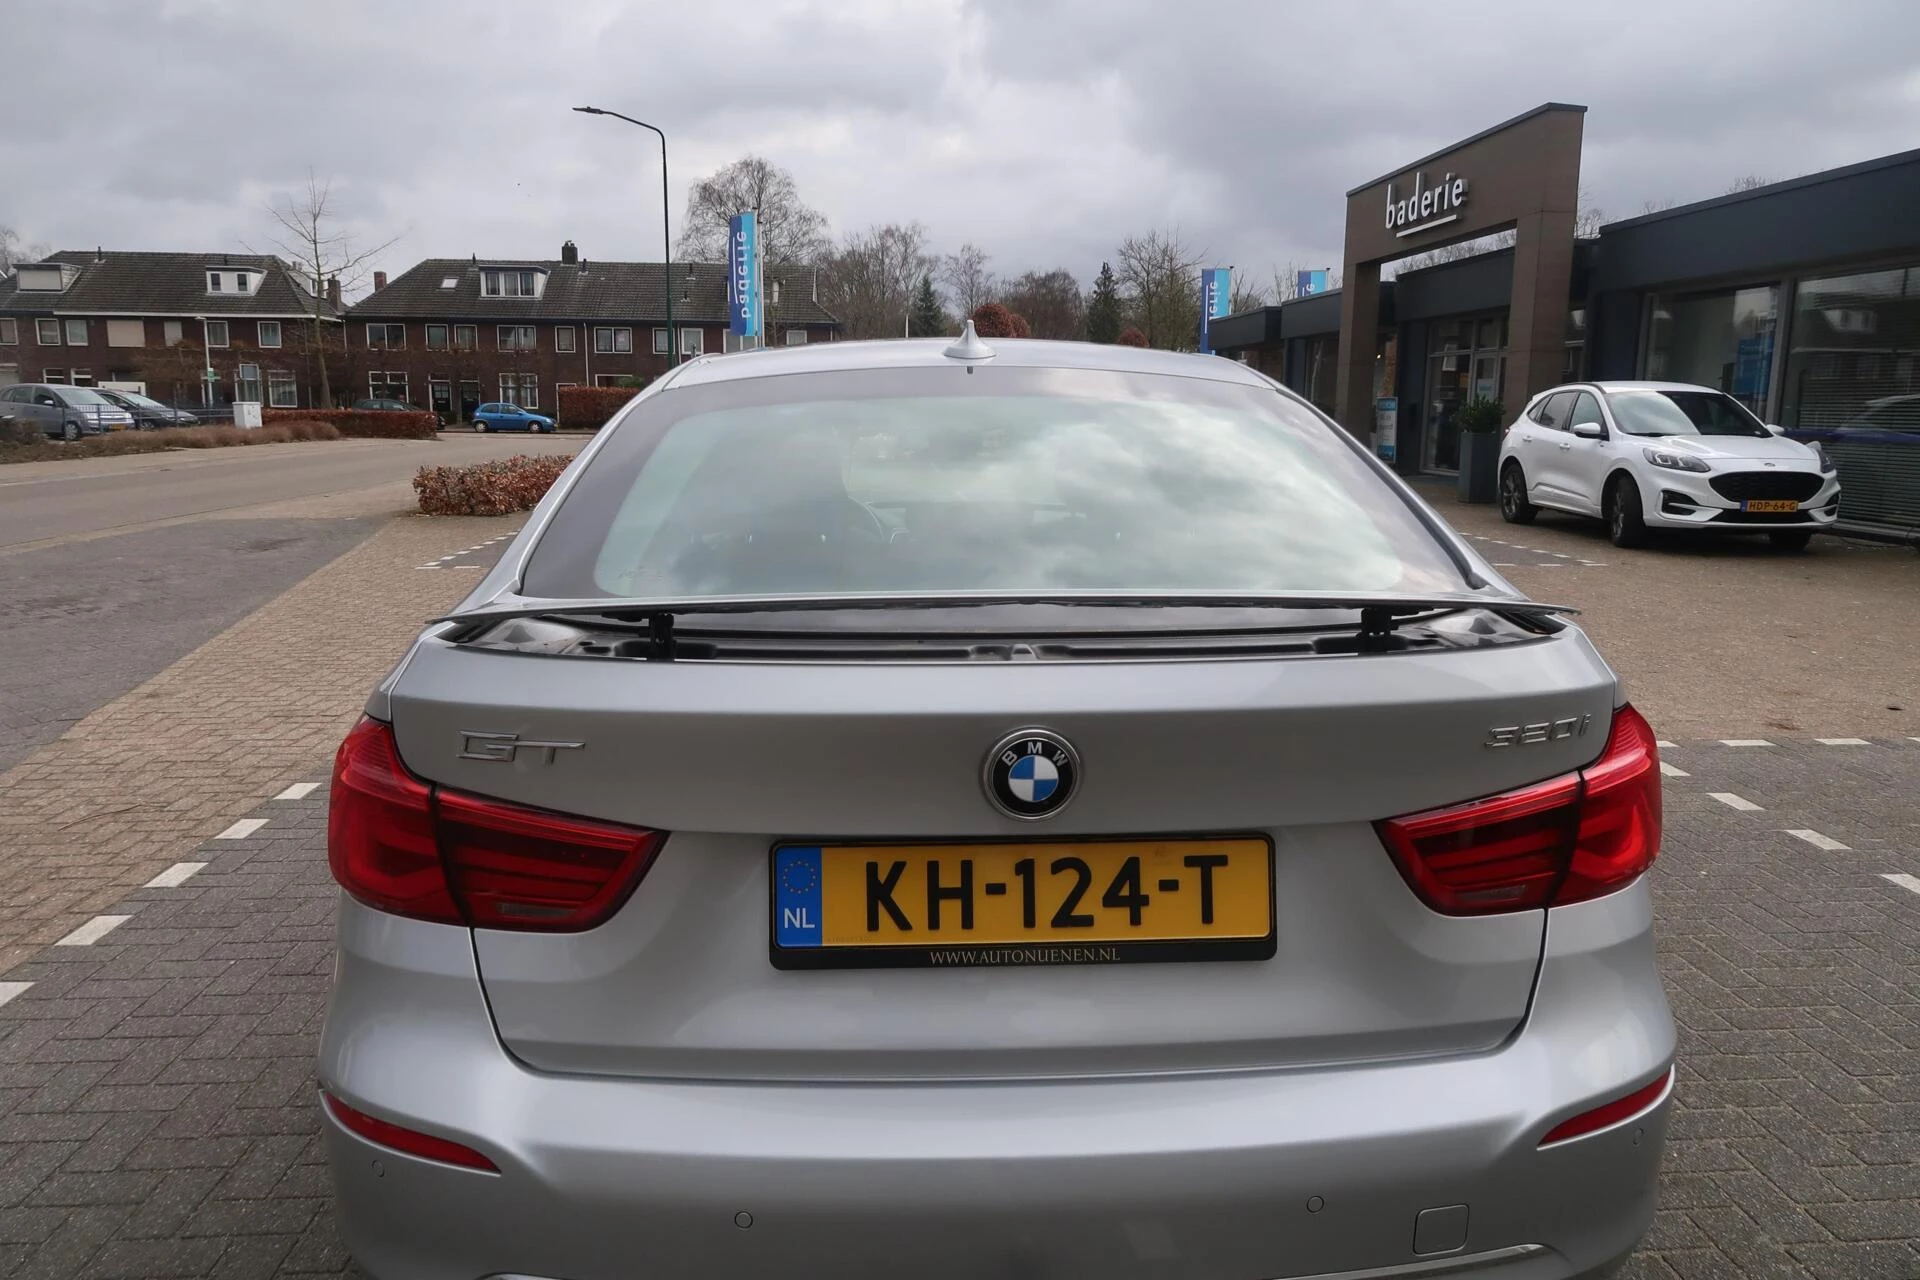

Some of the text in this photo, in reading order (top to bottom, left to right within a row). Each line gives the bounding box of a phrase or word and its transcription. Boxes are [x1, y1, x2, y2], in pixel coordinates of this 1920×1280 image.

[1385, 172, 1463, 229] baderie
[1748, 501, 1796, 511] HDP-64-G
[1484, 713, 1592, 748] 320i
[456, 729, 586, 768] GT
[1001, 741, 1068, 767] BMW
[866, 854, 1229, 932] KH-124-T
[783, 907, 816, 929] NL
[929, 948, 1121, 964] WWW.AUTONUENEN.NL
